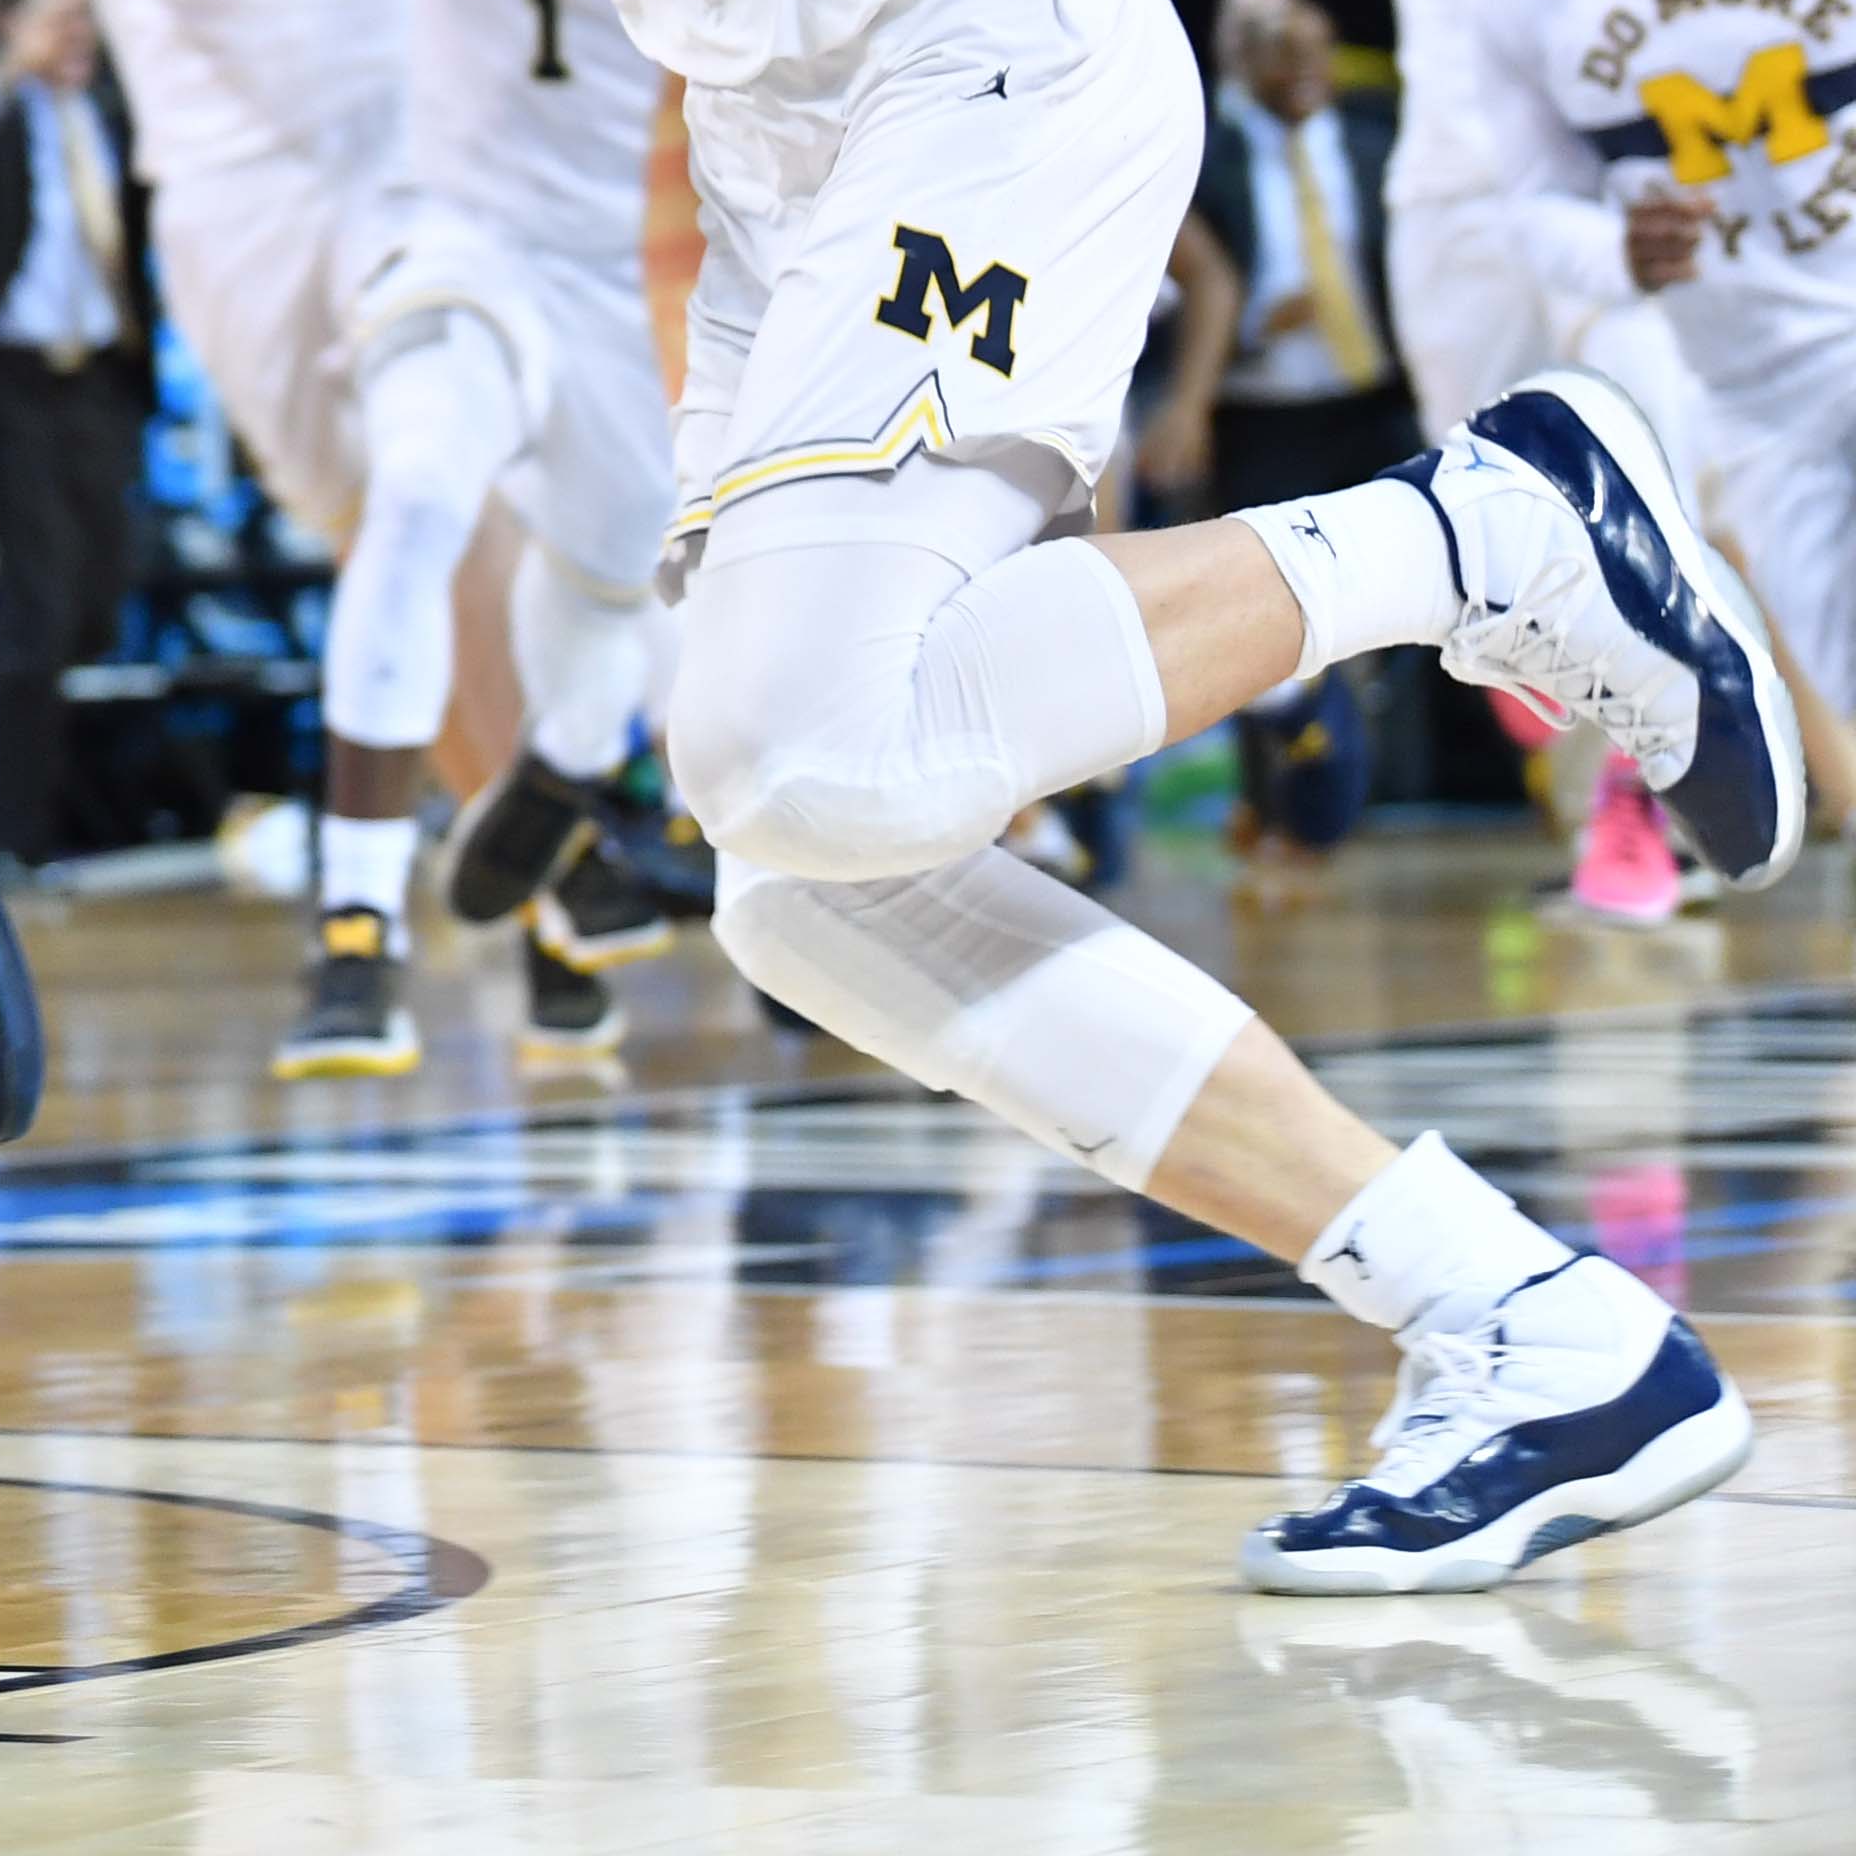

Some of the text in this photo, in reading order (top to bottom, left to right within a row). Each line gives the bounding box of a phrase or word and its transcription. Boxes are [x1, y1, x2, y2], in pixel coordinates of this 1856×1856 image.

[1582, 7, 1647, 91] DO
[1639, 38, 1830, 185] M
[874, 221, 1028, 380] M
